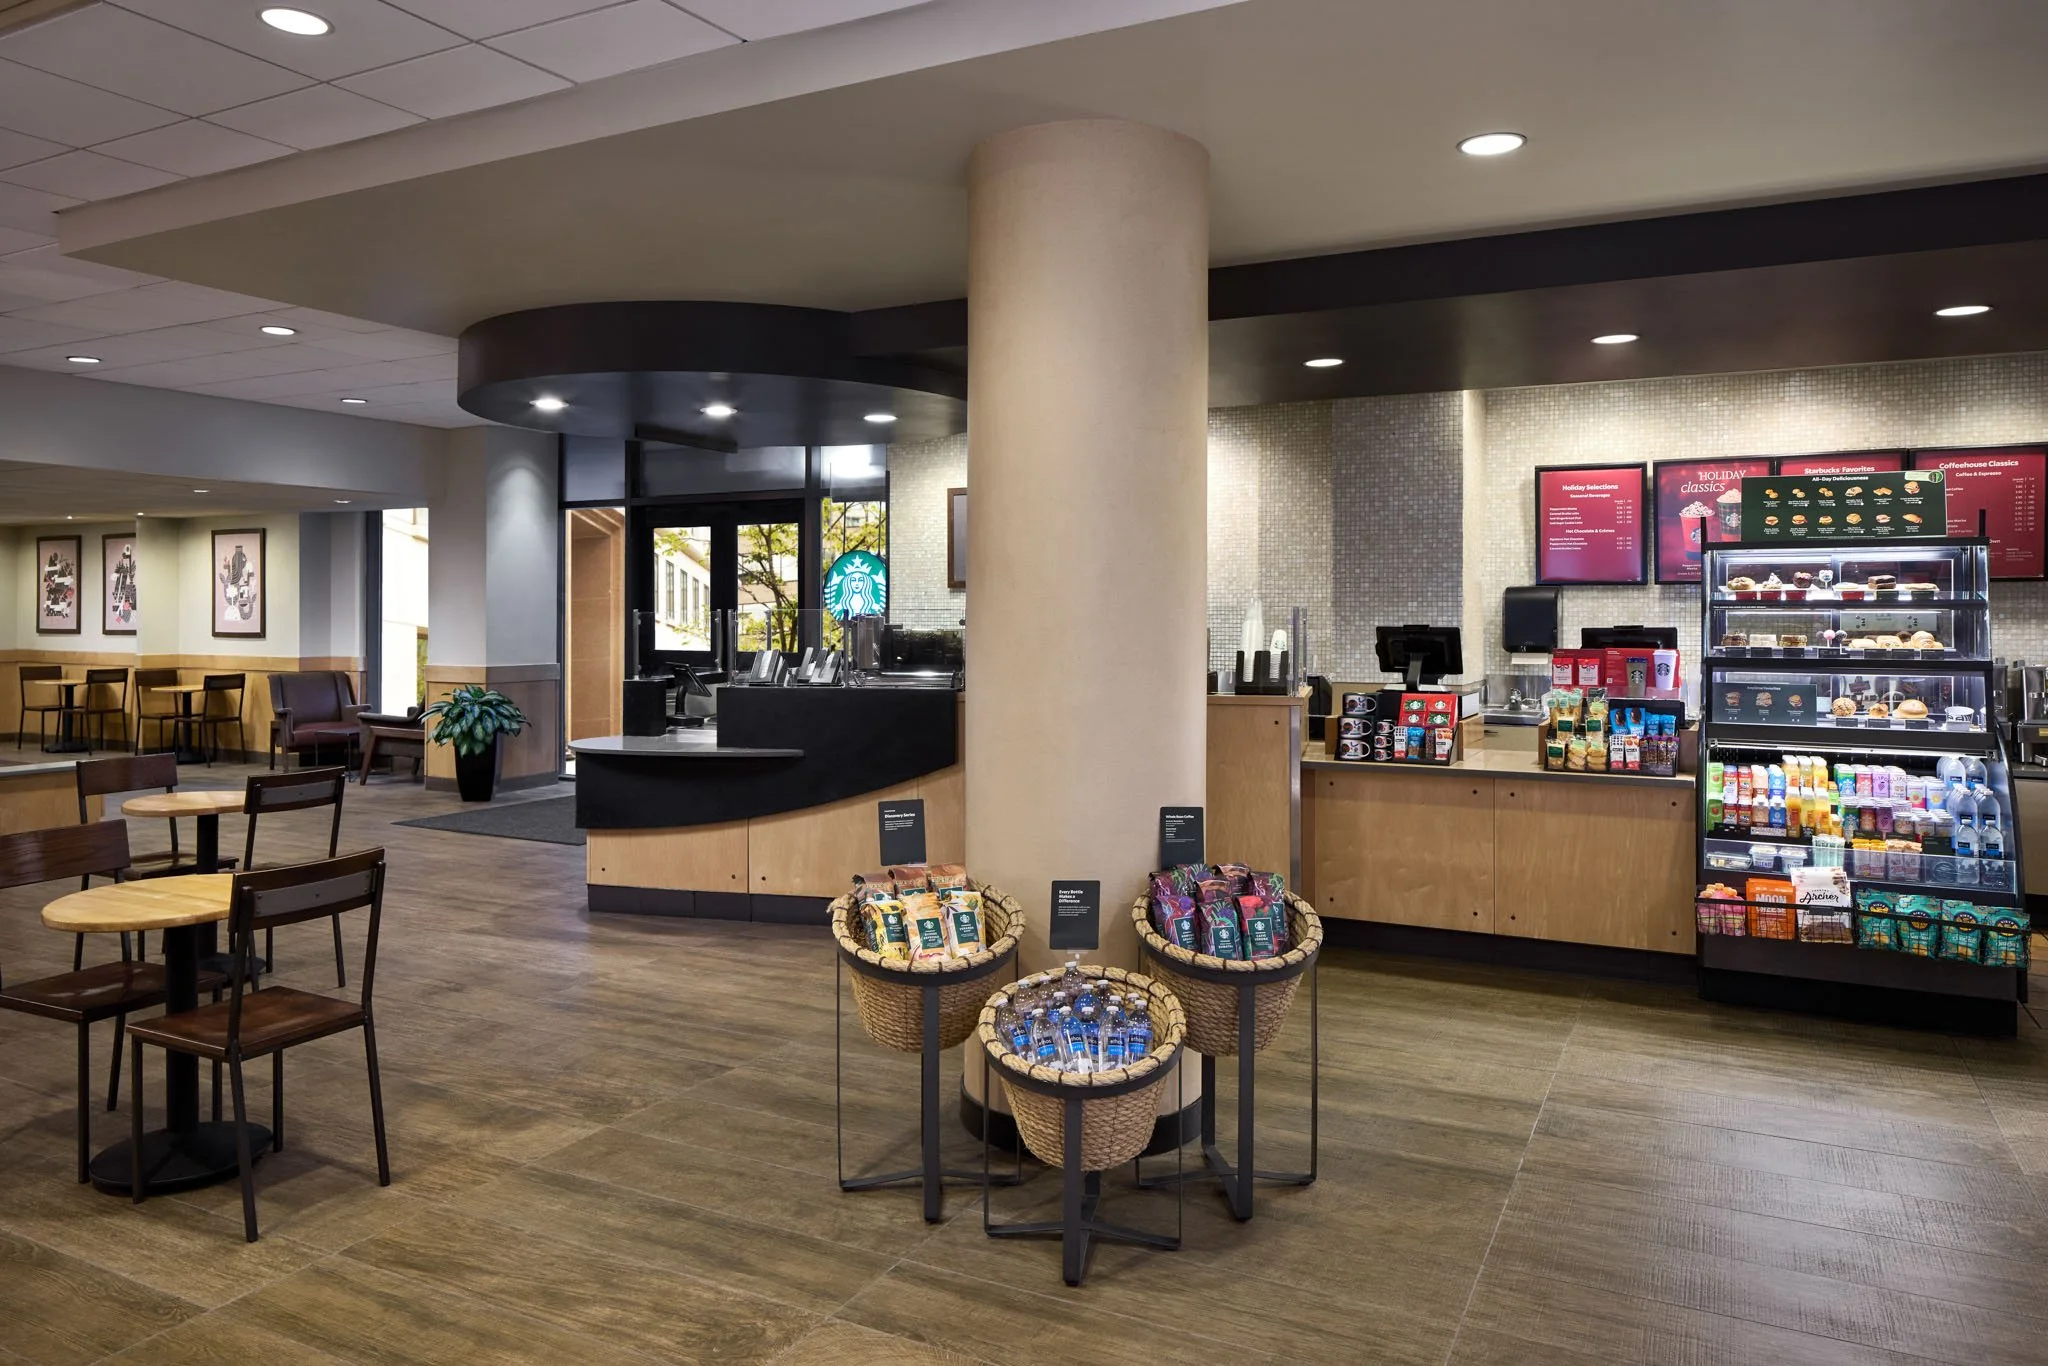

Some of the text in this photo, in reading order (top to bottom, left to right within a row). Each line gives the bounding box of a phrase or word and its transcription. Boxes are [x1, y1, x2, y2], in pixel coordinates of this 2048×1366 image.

[1939, 459, 2019, 470] Coffeehouse Classics
[1699, 470, 1746, 480] HOLIDAY
[1804, 465, 1875, 475] Starbucks Favorites
[1586, 483, 1619, 491] Selections
[1680, 481, 1725, 493] classics
[1800, 892, 1840, 905] Archer
